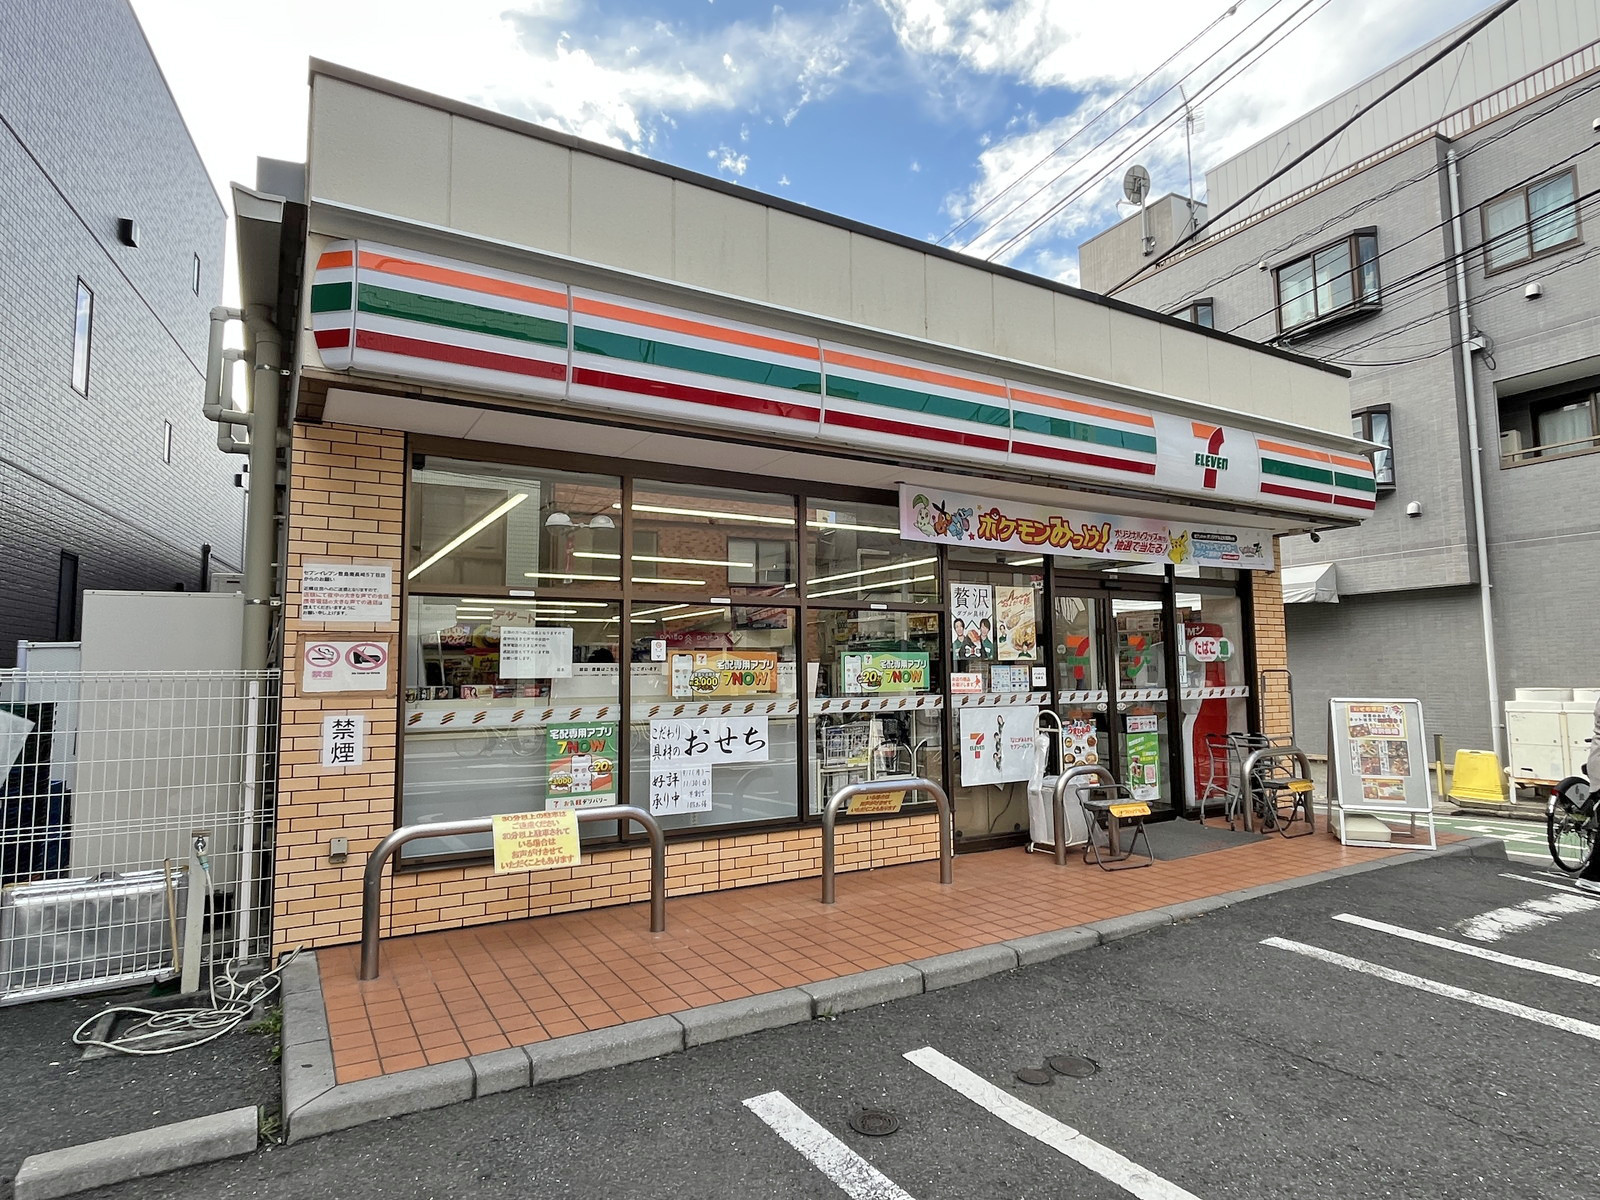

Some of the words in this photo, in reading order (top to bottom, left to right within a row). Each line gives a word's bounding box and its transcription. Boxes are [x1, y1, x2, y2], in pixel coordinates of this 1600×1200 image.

[954, 586, 989, 609] 贅沢
[1194, 640, 1216, 655] たばこ
[716, 659, 775, 671] 宅配専用アプリ
[722, 671, 768, 686] 7NOW
[885, 670, 922, 684] 7NOW
[549, 726, 613, 740] 宅配専用アプリ
[652, 725, 681, 740] こだわり
[331, 718, 355, 764] 禁煙
[557, 739, 606, 754] 7NOW
[684, 726, 766, 756] おせち
[652, 743, 681, 761] 具材の
[652, 772, 680, 788] 好評
[652, 791, 680, 810] 承り中
